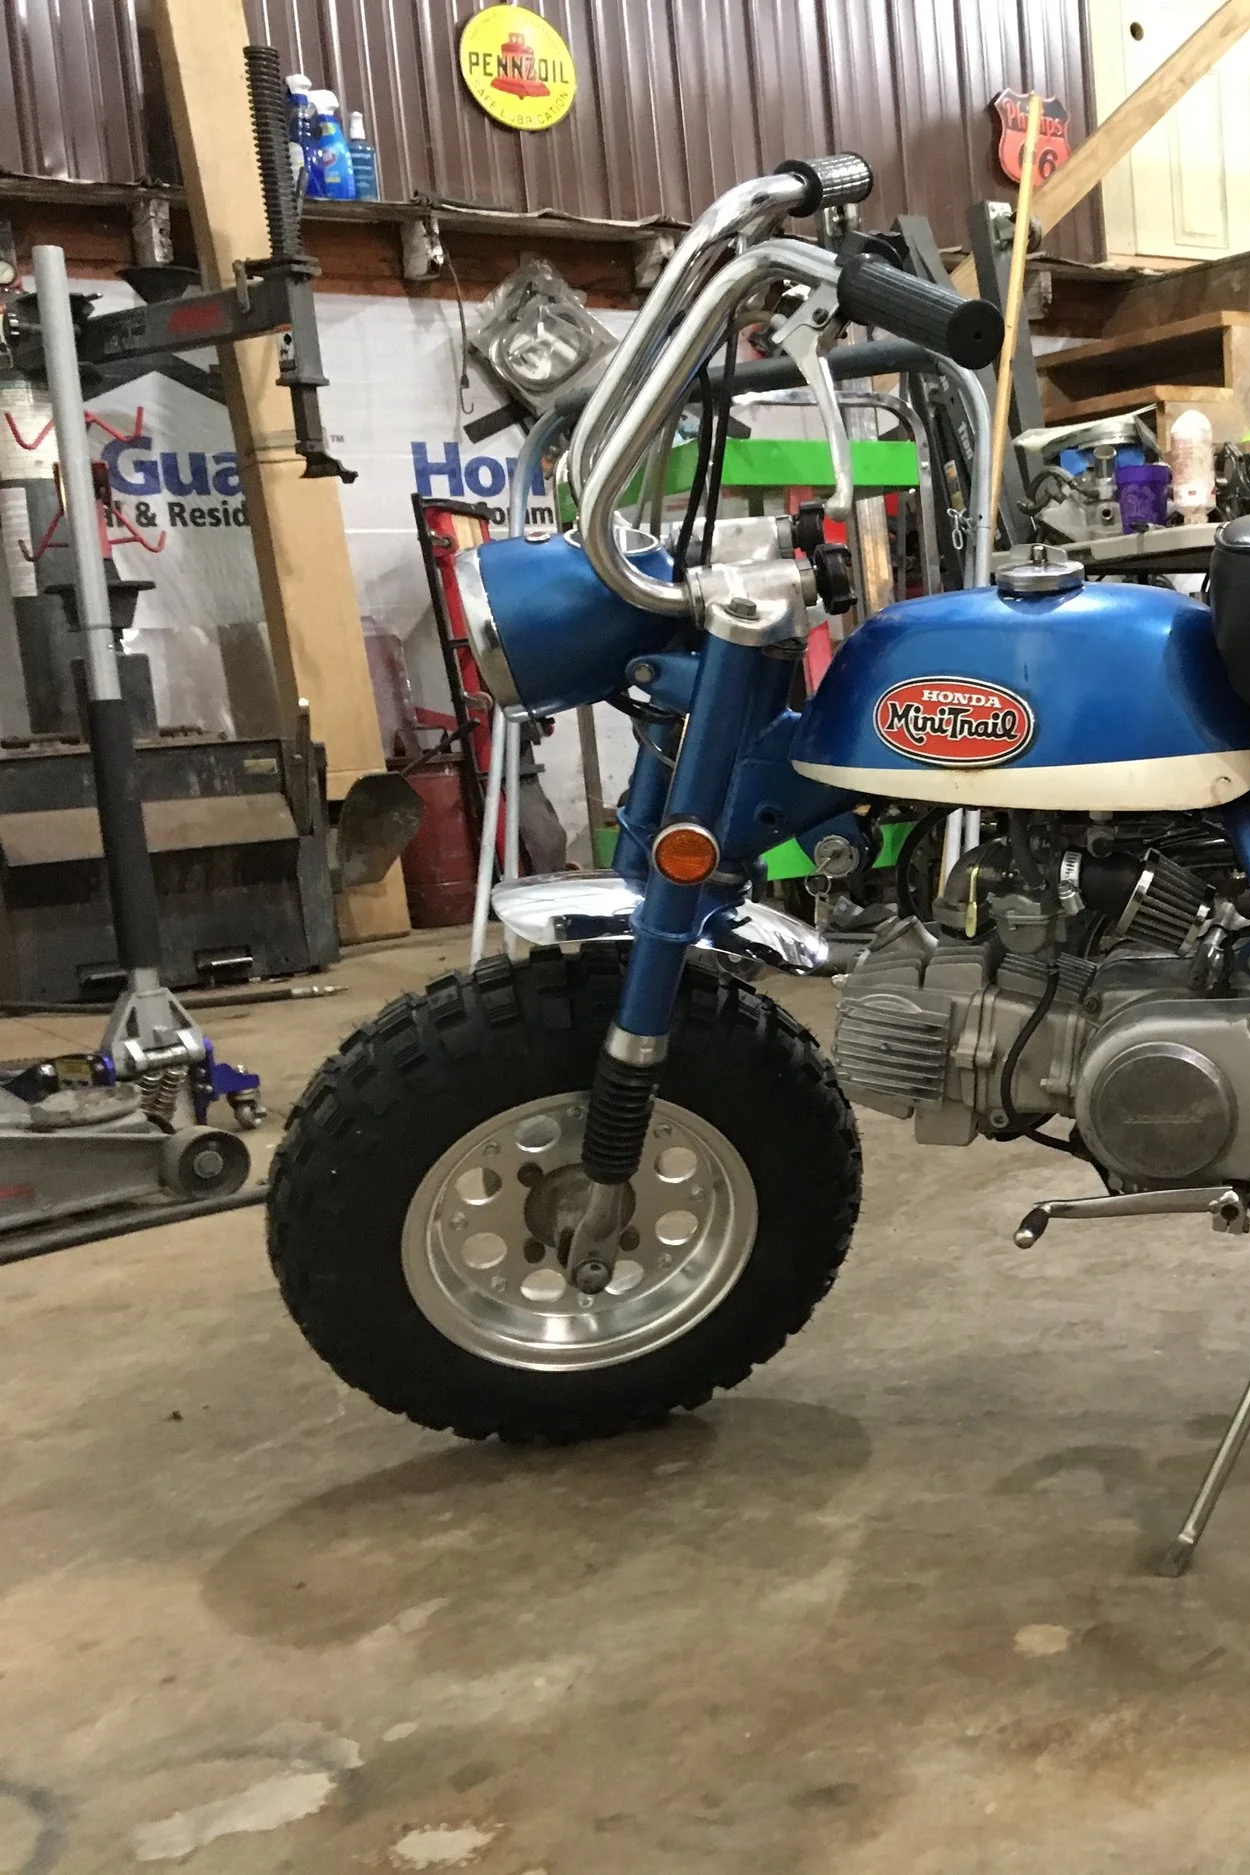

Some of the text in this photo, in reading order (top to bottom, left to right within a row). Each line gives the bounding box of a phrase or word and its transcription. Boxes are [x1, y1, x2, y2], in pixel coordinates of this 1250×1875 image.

[468, 51, 569, 84] PENNZOIL
[472, 79, 569, 125] SAFE LUBRICATION
[135, 500, 158, 528] &
[168, 499, 251, 528] Resid
[921, 689, 1001, 709] HONDA
[885, 702, 1019, 745] MiniTrail
